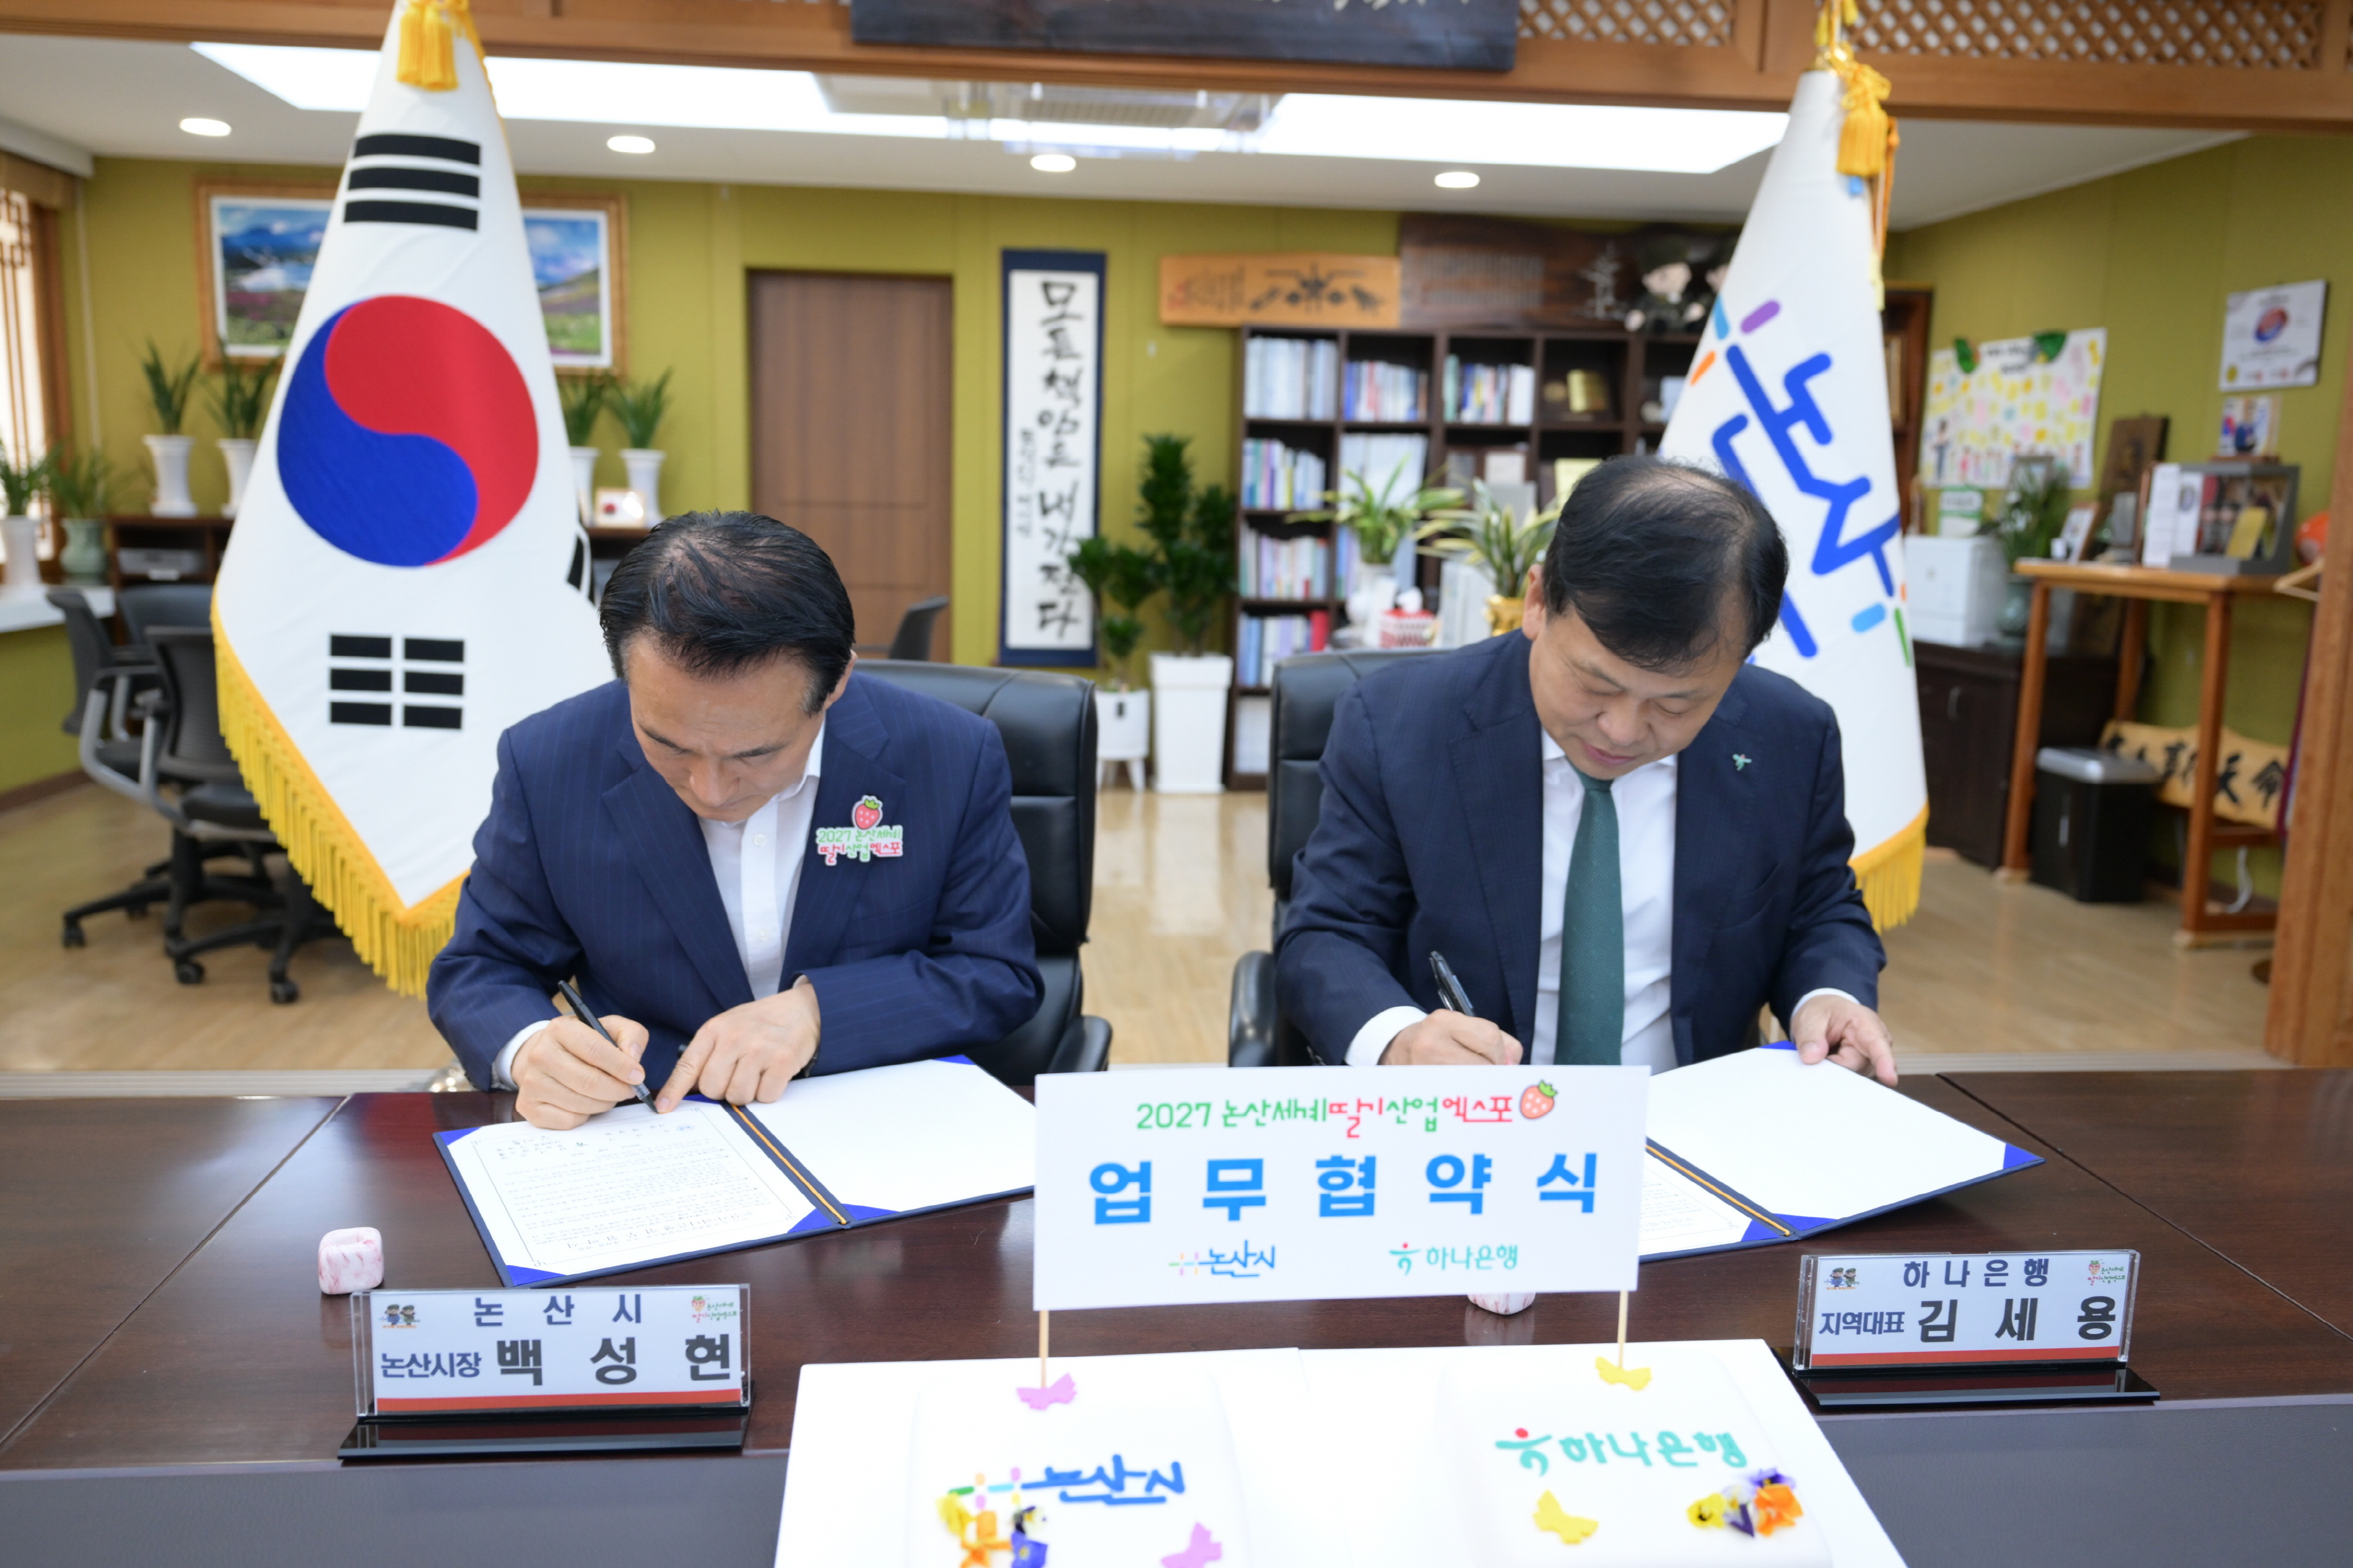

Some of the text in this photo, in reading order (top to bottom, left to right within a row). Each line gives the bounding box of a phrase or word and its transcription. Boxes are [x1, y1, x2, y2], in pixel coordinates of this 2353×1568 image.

[818, 828, 902, 843] 2027 논산세계
[820, 842, 902, 863] 딸기산업엑스포
[1137, 1102, 1212, 1130] 2027
[1198, 1239, 1276, 1278] 논산시
[1426, 1245, 1518, 1270] 하나은행
[1819, 1311, 1905, 1335] 지역대표
[381, 1352, 482, 1378] 논산시장
[1559, 1431, 1747, 1468] 하나은행
[1020, 1454, 1186, 1506] 논산시
